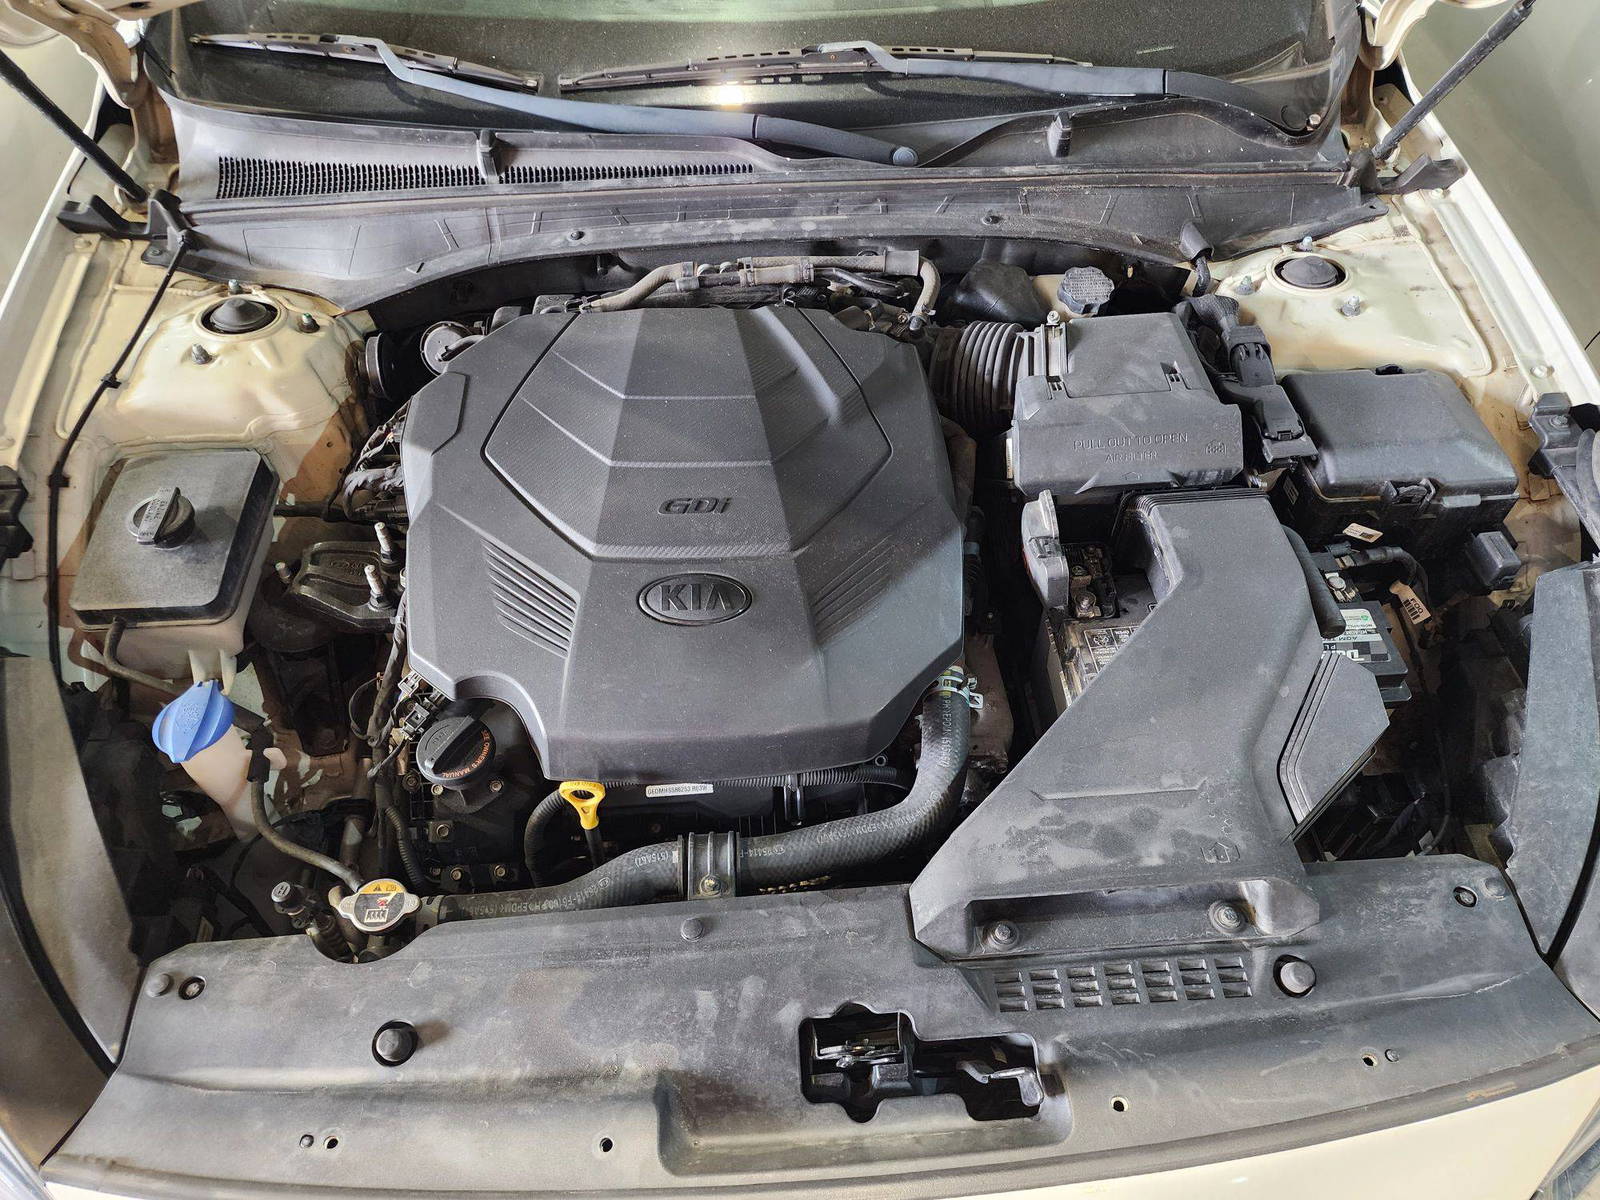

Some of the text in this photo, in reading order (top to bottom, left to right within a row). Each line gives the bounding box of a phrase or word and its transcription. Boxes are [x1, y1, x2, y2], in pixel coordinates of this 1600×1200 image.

[1072, 432, 1189, 451] PULL OUT TO OPEN
[660, 583, 735, 611] KIA
[441, 767, 471, 778] MANUAL
